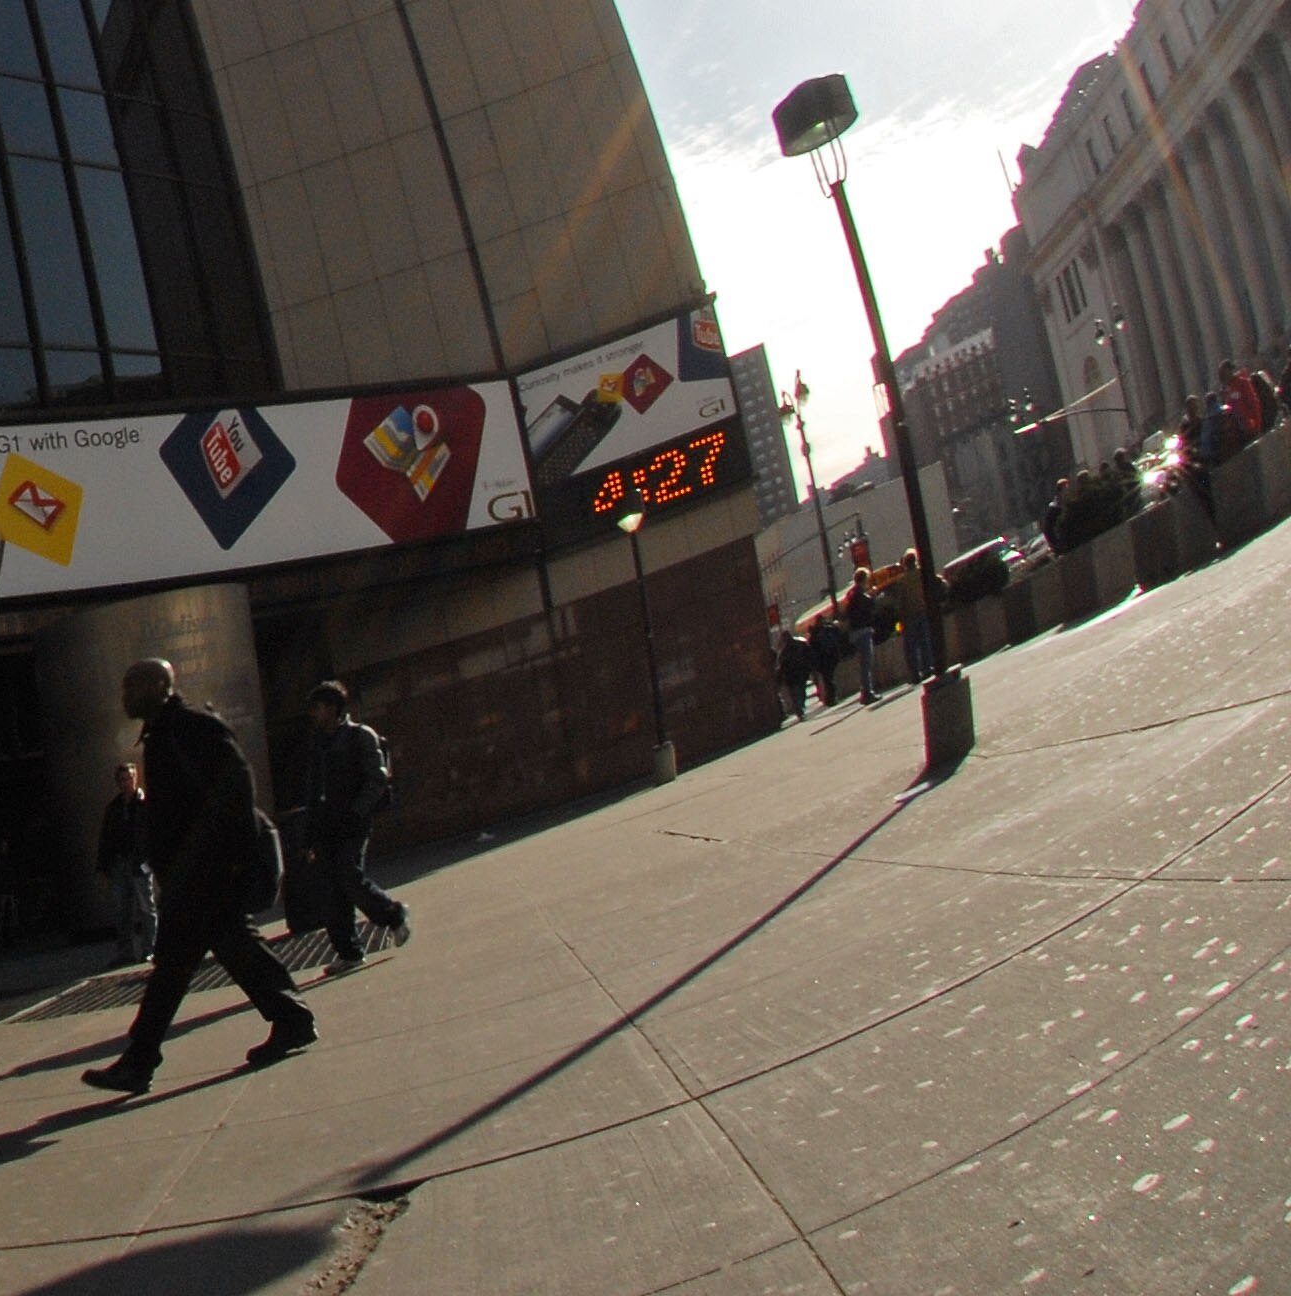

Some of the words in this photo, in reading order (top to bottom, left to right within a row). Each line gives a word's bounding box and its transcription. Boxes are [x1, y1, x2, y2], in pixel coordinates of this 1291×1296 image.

[29, 431, 69, 452] with
[73, 426, 141, 450] Google
[227, 415, 245, 452] You
[206, 426, 233, 483] Tube
